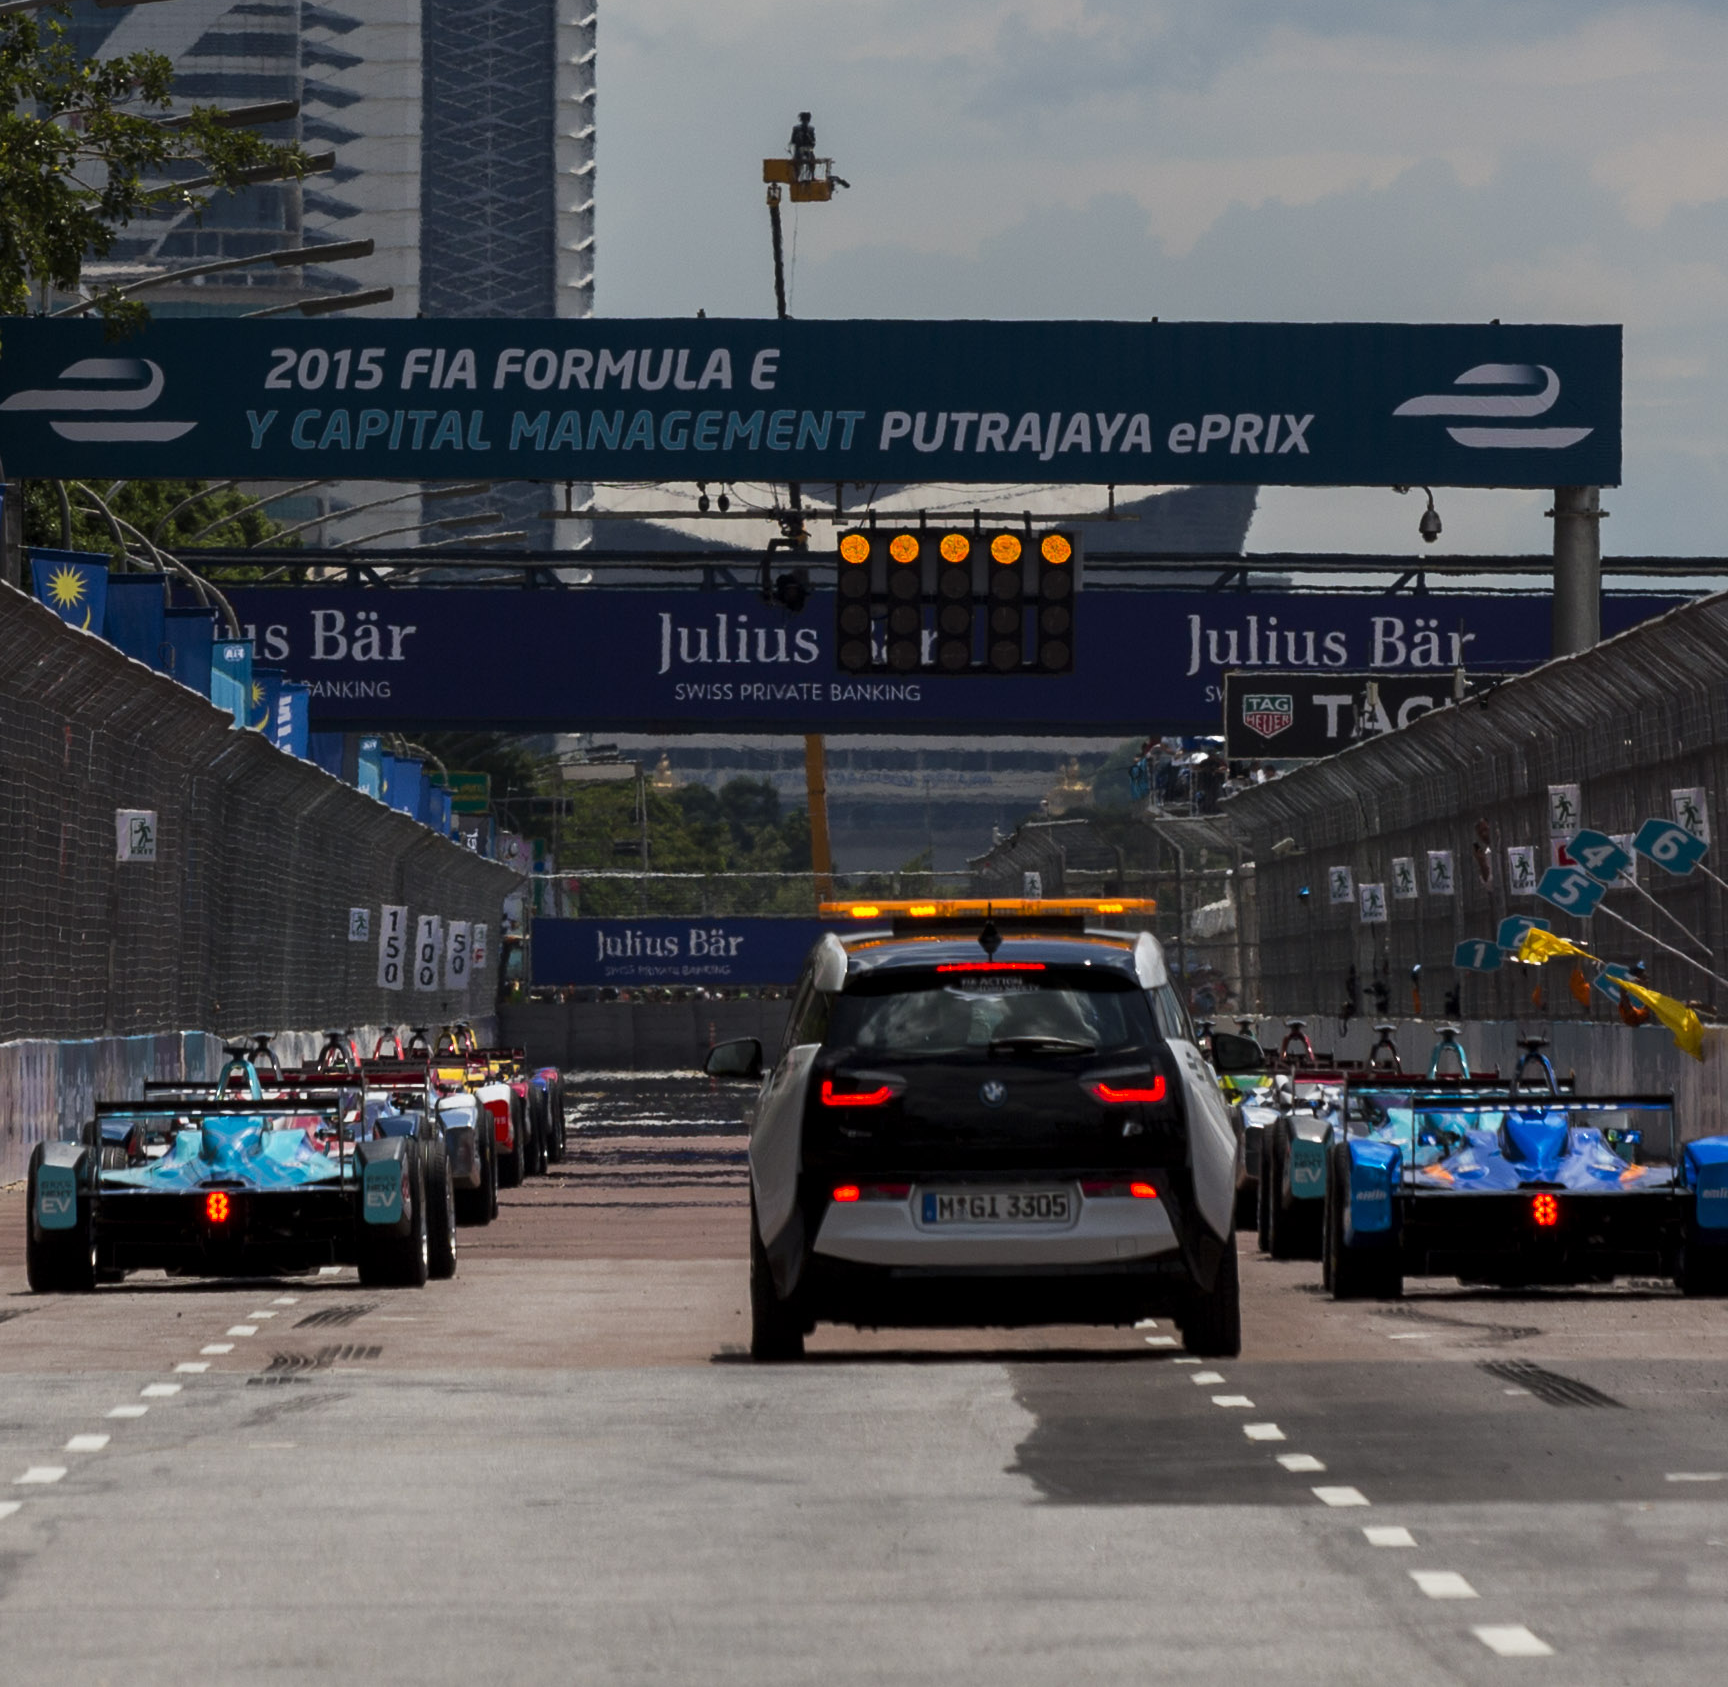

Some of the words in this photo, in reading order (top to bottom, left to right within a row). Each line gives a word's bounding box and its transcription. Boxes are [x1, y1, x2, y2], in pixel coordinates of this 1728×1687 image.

[264, 348, 386, 391] 2015
[401, 348, 478, 391] FIA
[493, 348, 734, 391] FORMULA
[749, 349, 781, 391] E
[246, 410, 275, 450] Y
[292, 410, 492, 452] CAPITAL
[510, 410, 865, 452] MANAGEMENT
[879, 411, 1153, 462] PUTRAJAYA
[1168, 413, 1315, 454] ePRIX
[310, 609, 417, 662] Bär
[659, 612, 819, 675] Julius
[1187, 614, 1347, 677] Julius
[1370, 616, 1476, 669] Bär
[675, 683, 734, 701] SWISS
[740, 684, 821, 702] PRIVATE
[830, 683, 921, 702] BANKING
[1248, 697, 1290, 712] TAG
[1244, 713, 1292, 736] HEUER
[130, 848, 154, 856] EXIT
[1581, 844, 1615, 870] 4
[1650, 829, 1690, 861] 6
[1551, 874, 1590, 906] 5
[384, 911, 399, 984] 150
[419, 920, 434, 986] 100
[452, 934, 466, 975] 50
[595, 929, 679, 962] Julius
[689, 929, 745, 958] Bär
[1472, 945, 1486, 966] 1
[1295, 1167, 1322, 1183] EV
[42, 1197, 71, 1213] EV
[367, 1191, 397, 1207] EV
[938, 1194, 955, 1216] M
[1007, 1193, 1067, 1217] 3305
